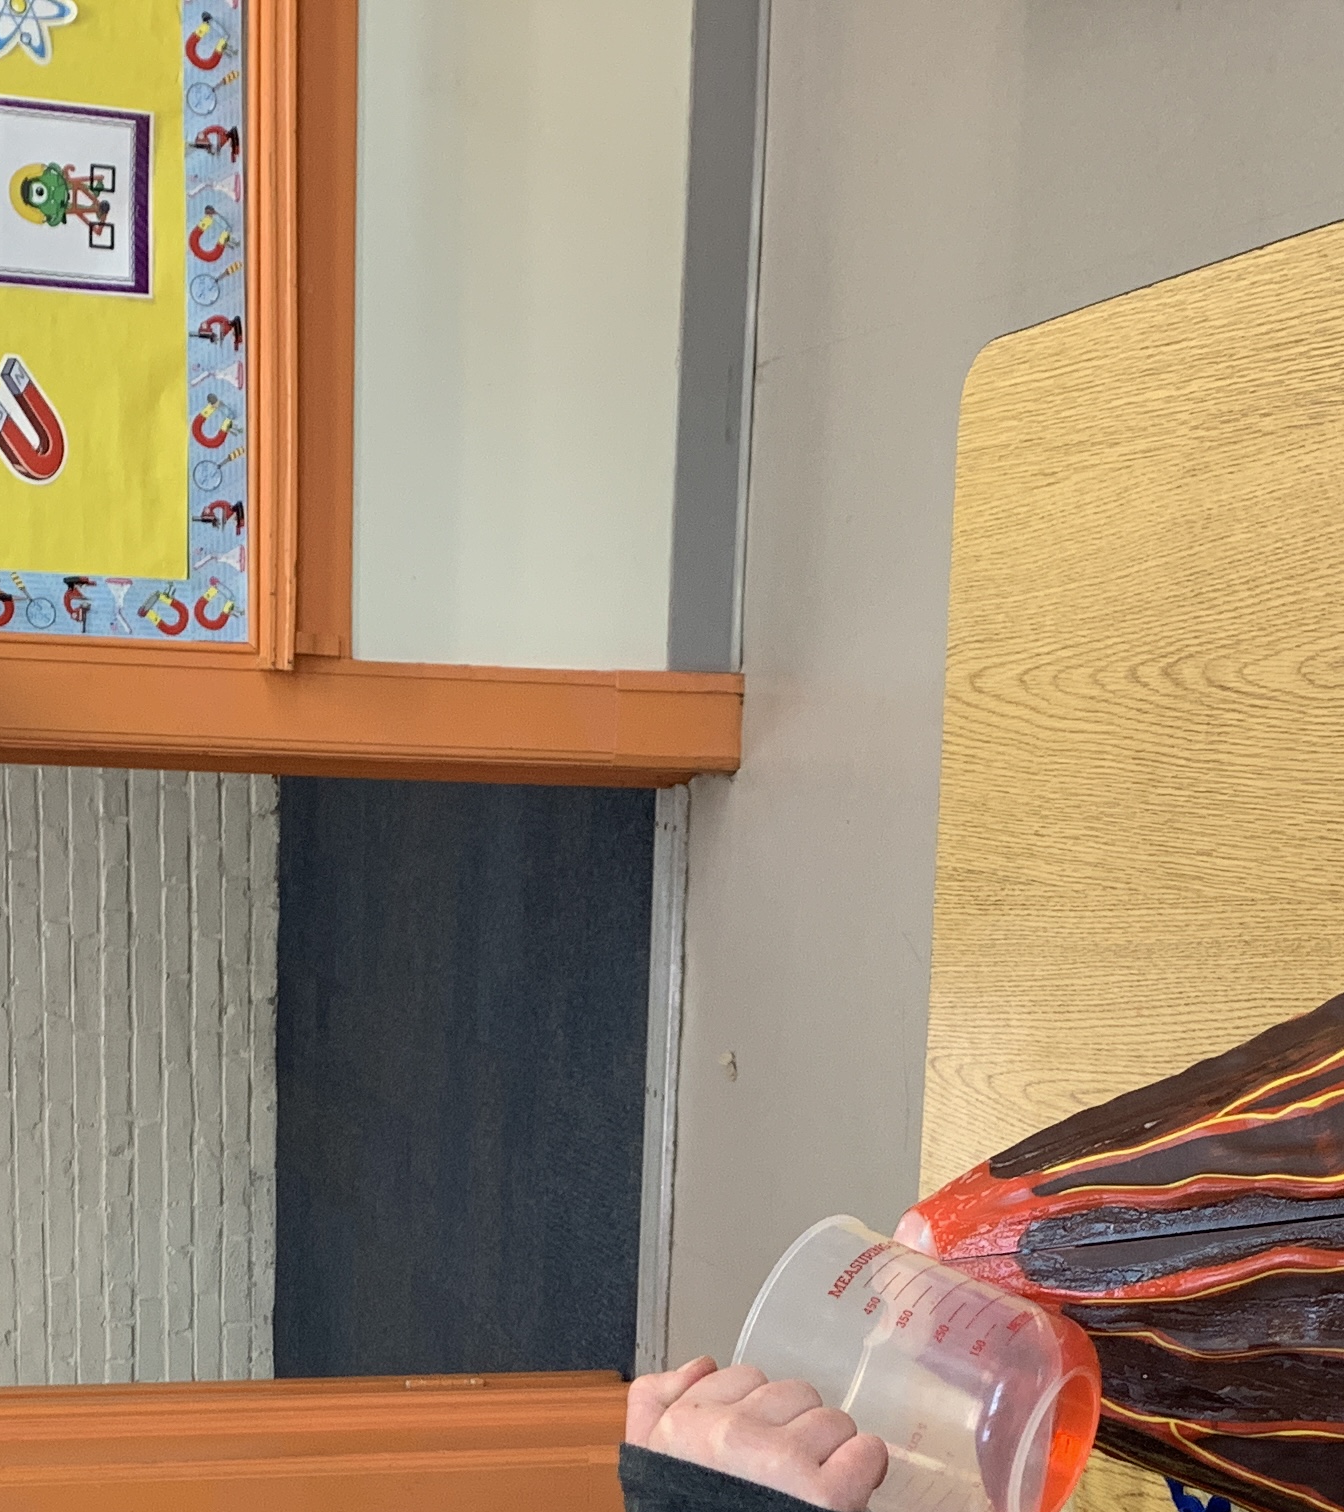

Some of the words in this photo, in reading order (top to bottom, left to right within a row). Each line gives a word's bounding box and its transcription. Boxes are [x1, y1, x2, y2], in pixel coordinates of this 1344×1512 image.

[13, 366, 25, 386] N
[863, 1295, 881, 1315] 450
[895, 1308, 914, 1329] 350
[932, 1323, 950, 1344] 250
[969, 1338, 987, 1357] 150
